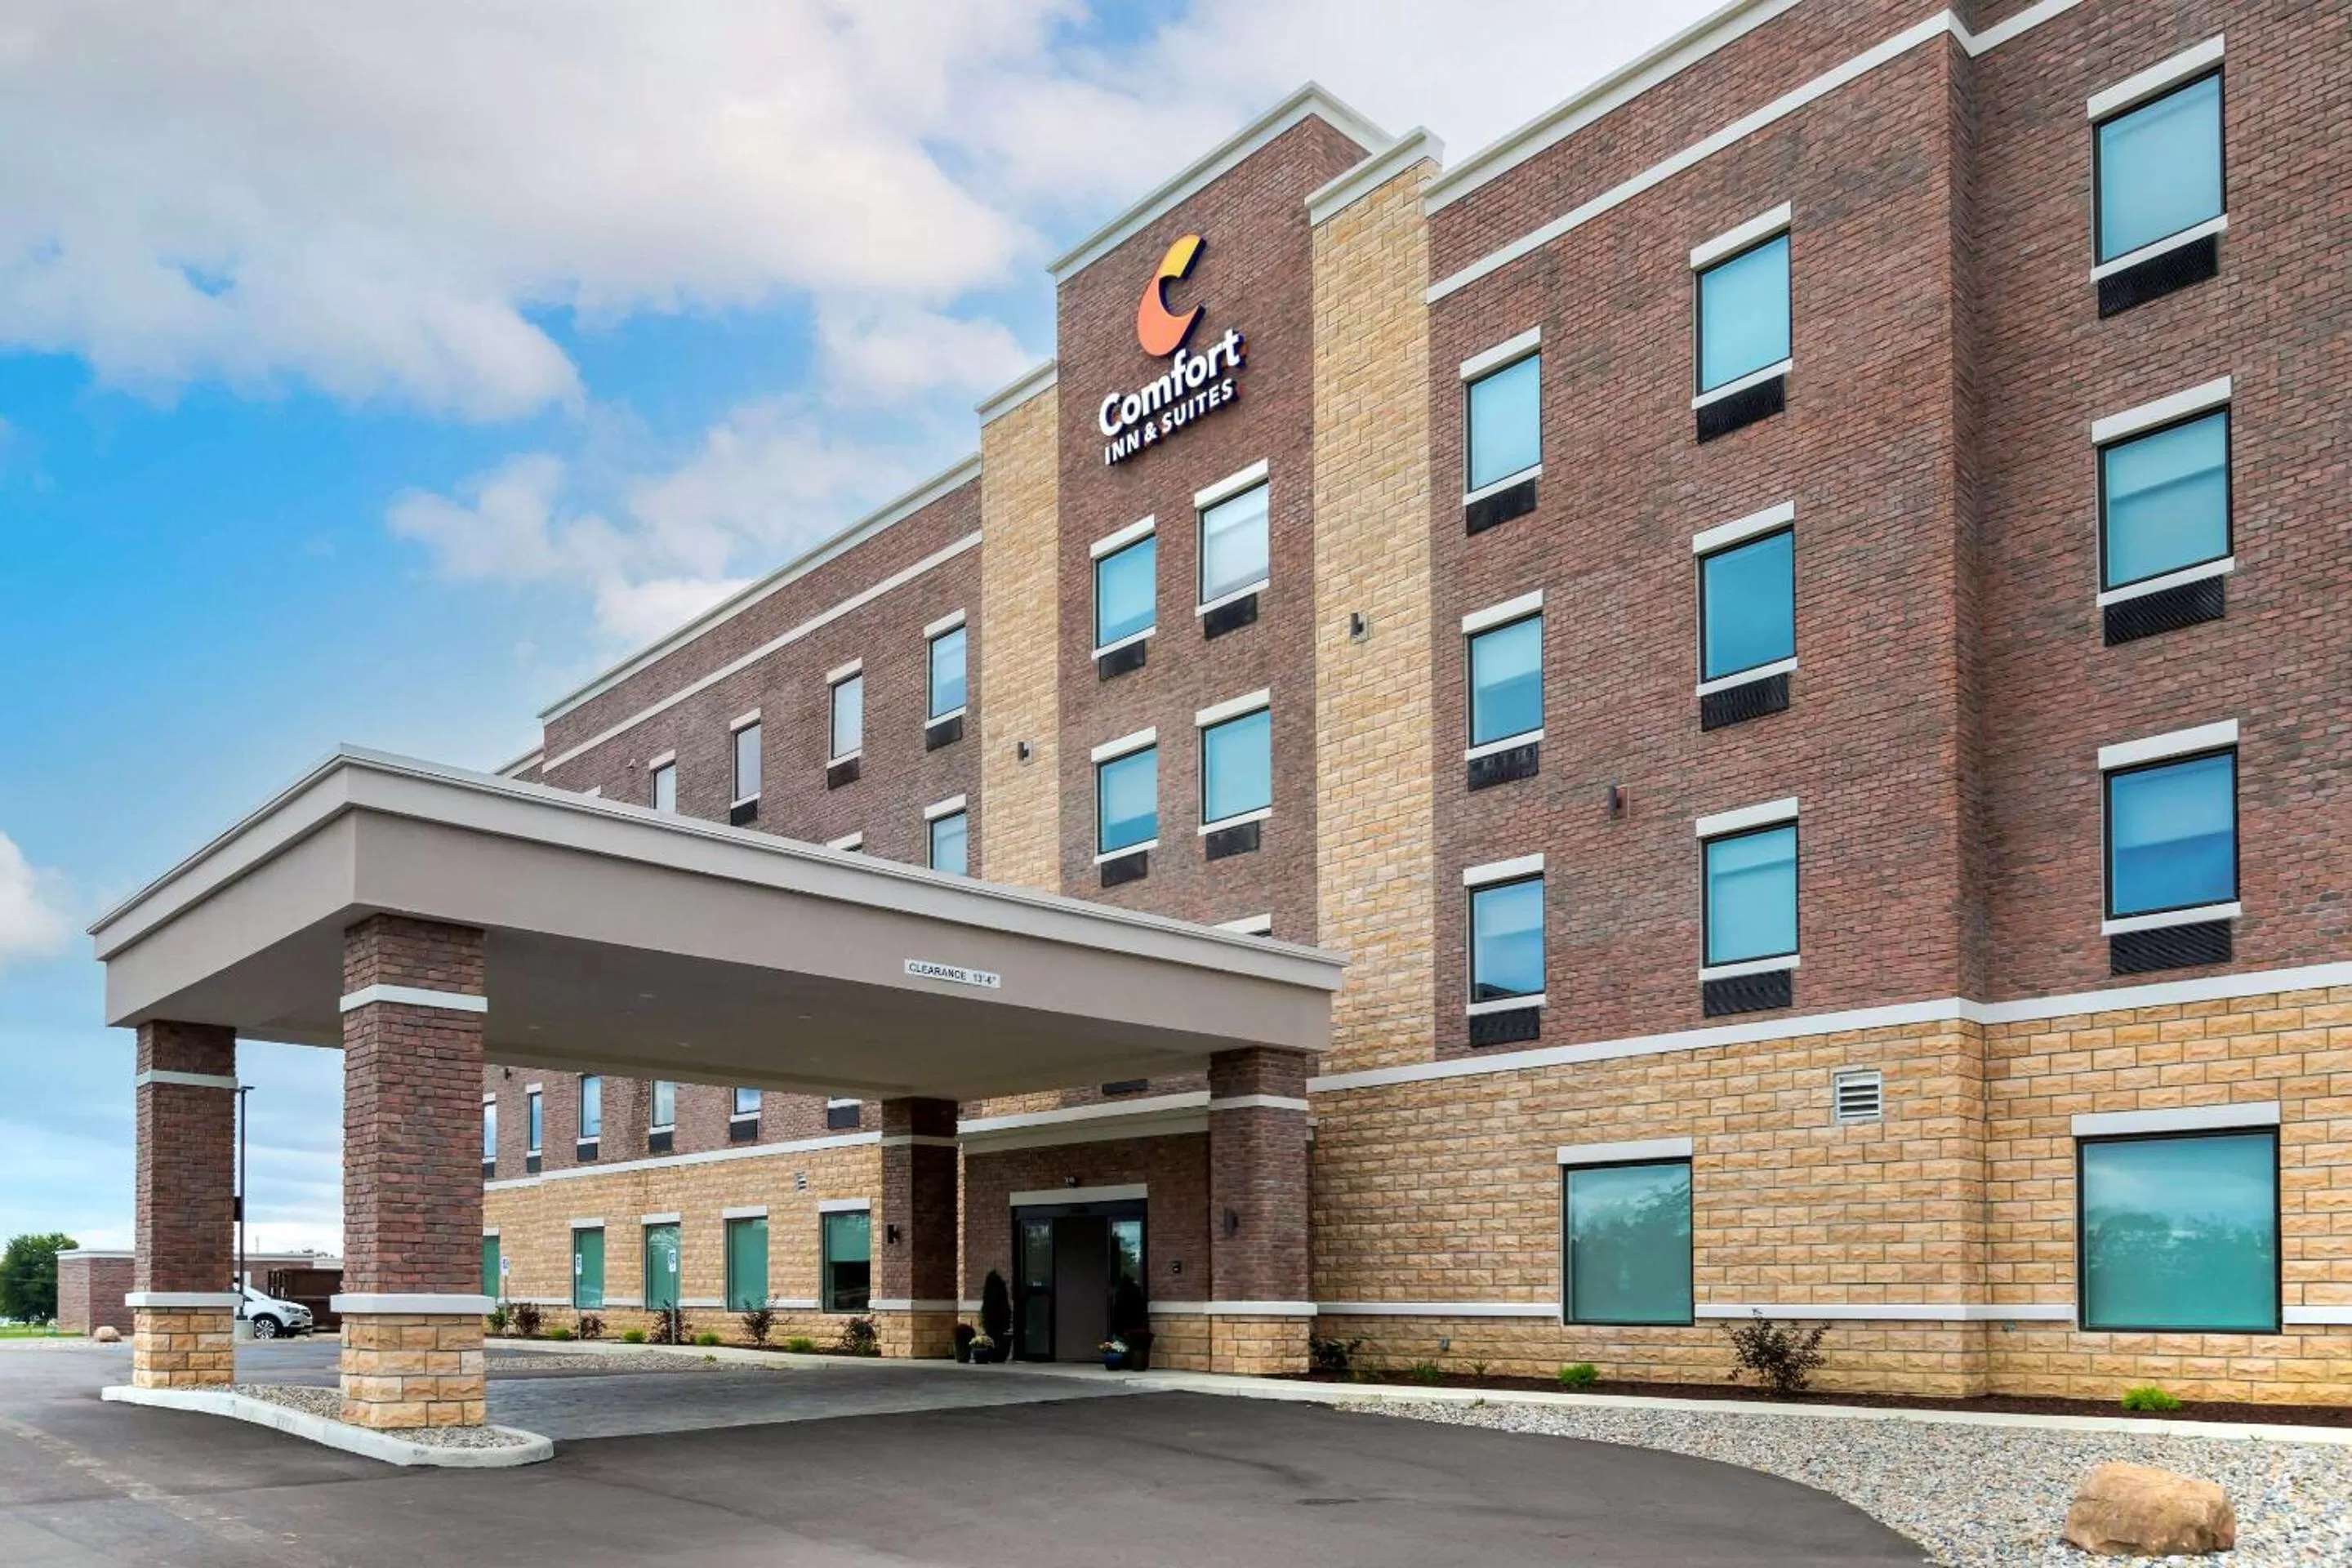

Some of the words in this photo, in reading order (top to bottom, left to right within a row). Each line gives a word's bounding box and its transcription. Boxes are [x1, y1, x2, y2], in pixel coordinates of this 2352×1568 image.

[1098, 327, 1241, 437] Comfort
[1105, 429, 1140, 466] INN
[1144, 421, 1158, 443] &
[1161, 377, 1233, 434] SUITES
[908, 962, 967, 981] CLEARANCE
